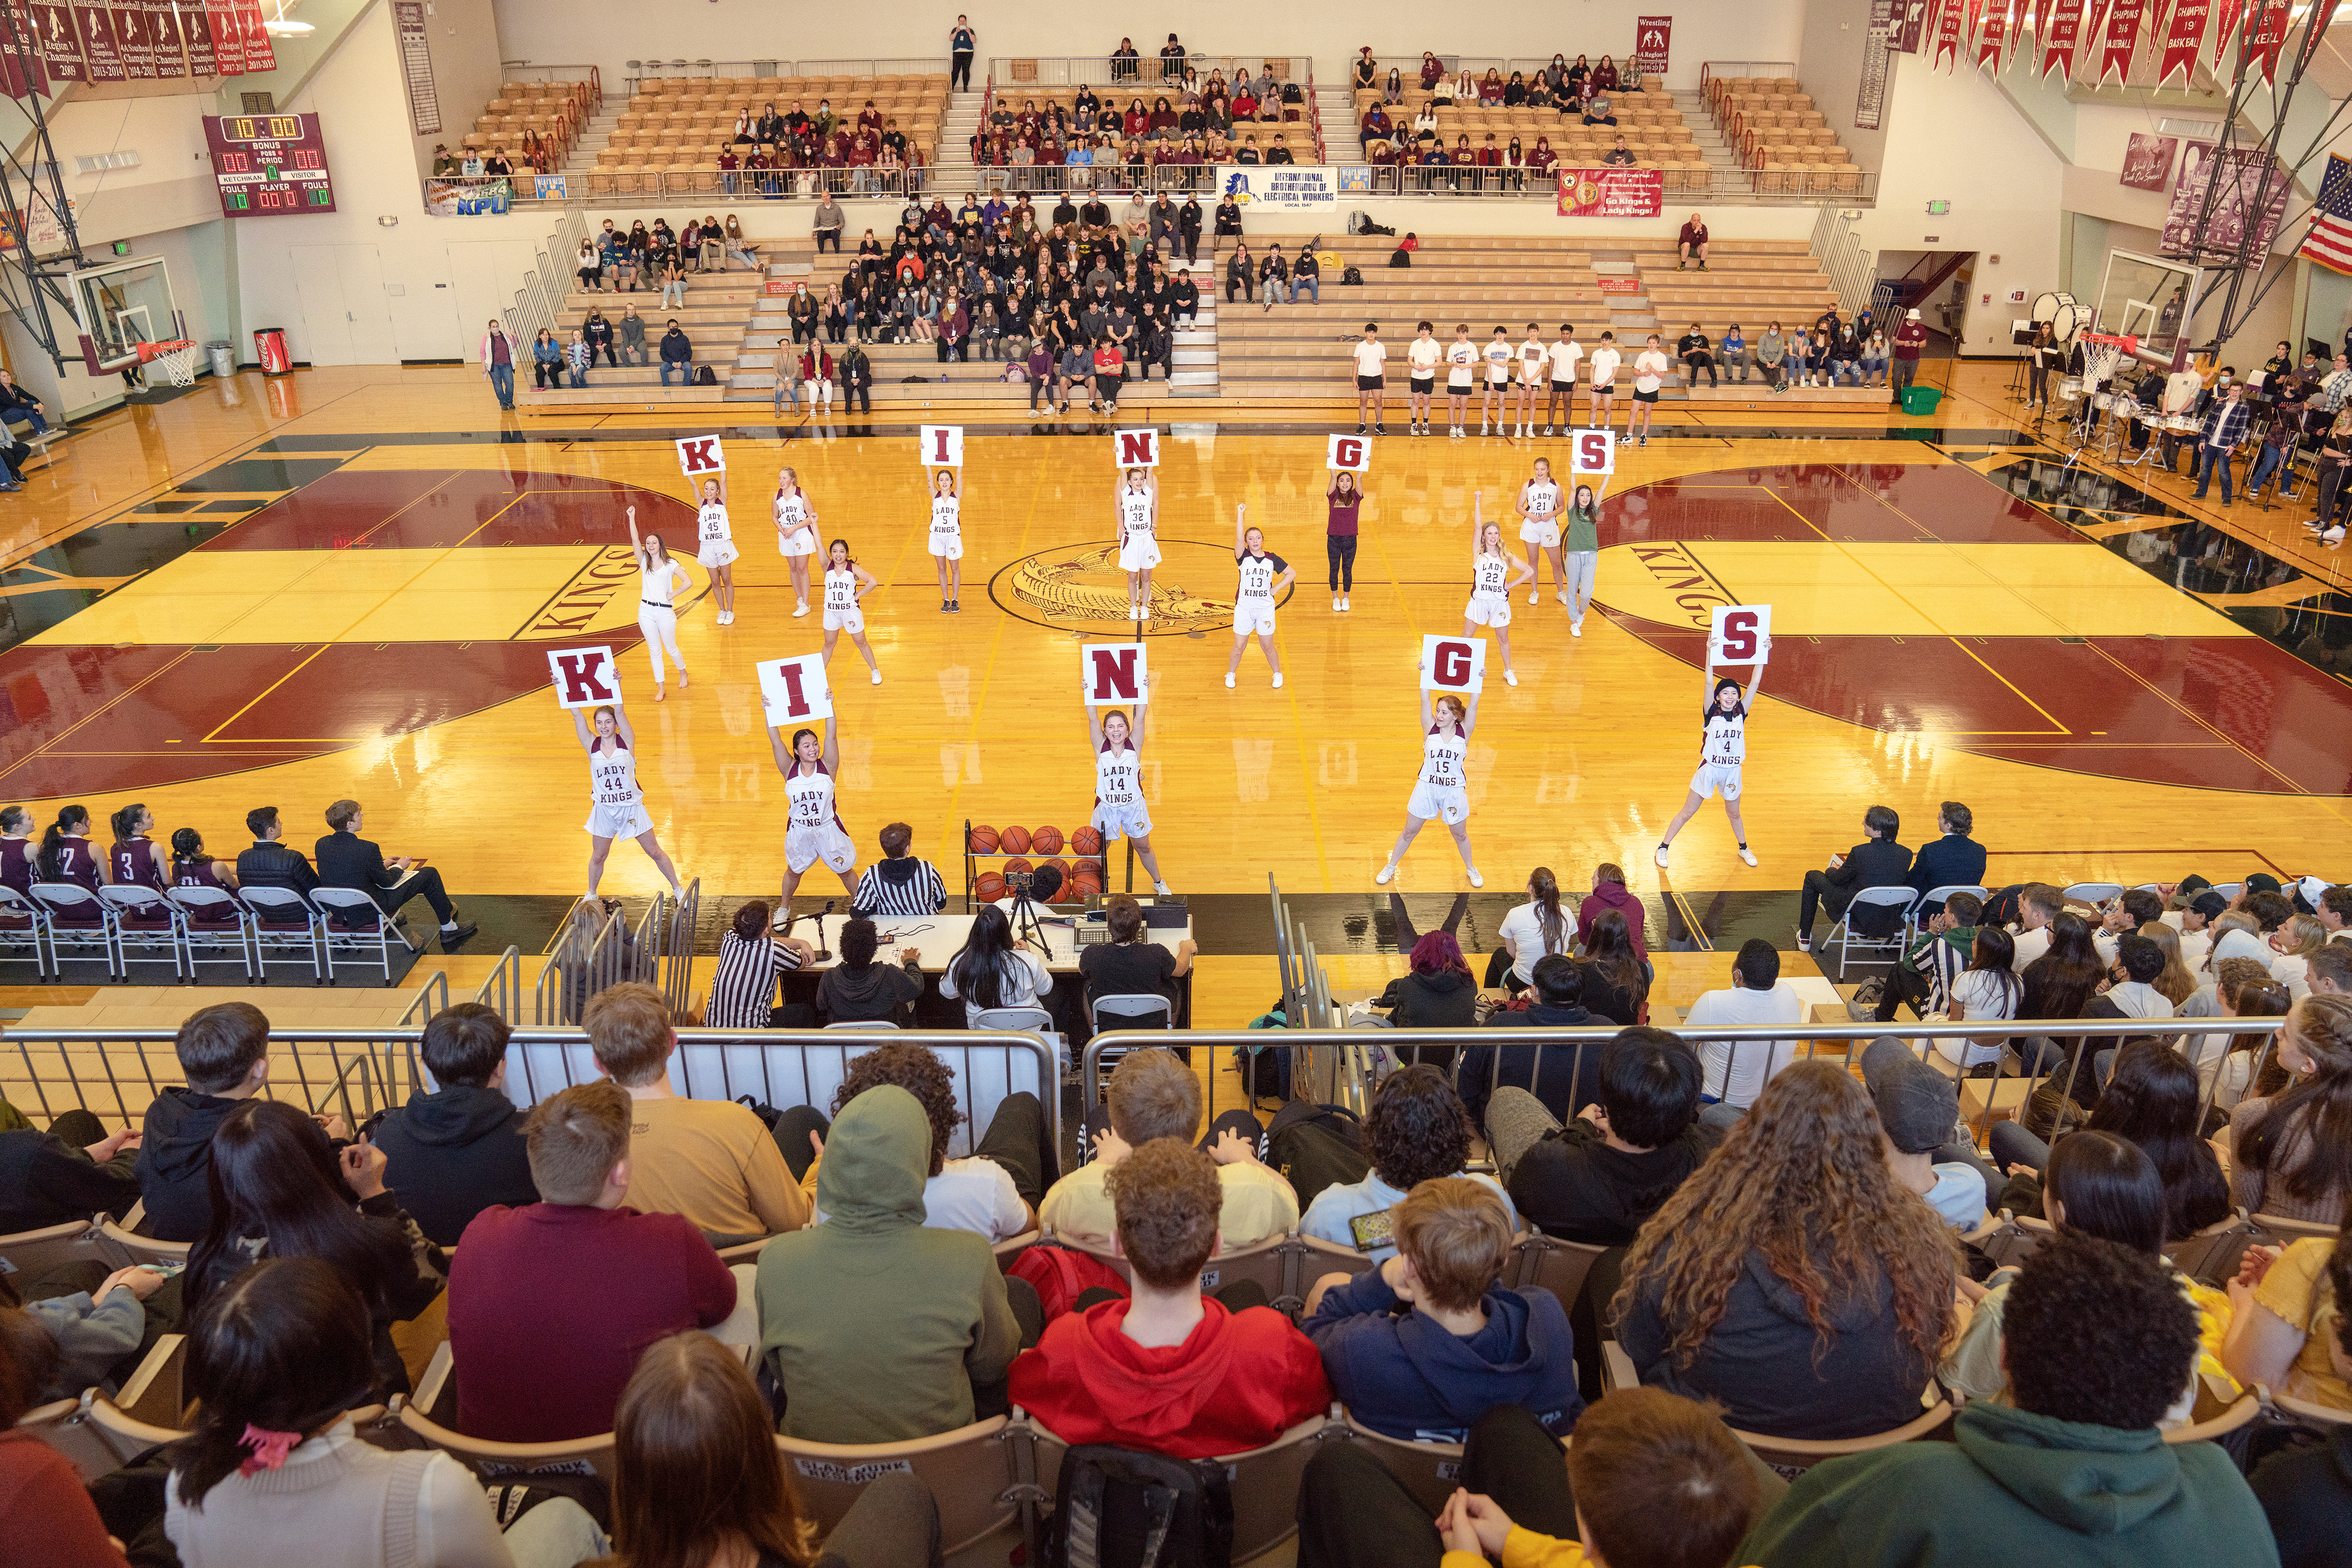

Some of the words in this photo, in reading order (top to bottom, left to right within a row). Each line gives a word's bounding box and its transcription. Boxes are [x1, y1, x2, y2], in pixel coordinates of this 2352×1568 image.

[73, 0, 106, 8] Basketball
[110, 0, 141, 10] Basketball
[142, 2, 172, 12] Basketball
[177, 3, 204, 12] Basketball
[206, 3, 233, 12] Basketball
[235, 2, 260, 10] Basketball
[1640, 19, 1671, 27] Wrestling
[44, 40, 68, 51] Region
[68, 41, 74, 51] V
[120, 44, 129, 52] 4A
[154, 45, 162, 53] 4A
[162, 44, 177, 53] Region
[188, 43, 196, 51] 4A
[196, 42, 209, 51] Region
[45, 51, 82, 63] Champions
[92, 50, 114, 58] Champions
[189, 55, 215, 63] Champions
[155, 55, 184, 65] Champions
[248, 59, 275, 70] 2018-2019
[60, 65, 76, 76] 2009
[93, 66, 124, 77] 2013-2014
[252, 142, 280, 150] BONUS
[1275, 172, 1323, 182] INTERNATIONAL
[221, 185, 248, 193] FOULS
[260, 183, 290, 191] PLAYER
[303, 181, 328, 189] FOULS
[1271, 183, 1316, 191] BROTHERHOOD
[1319, 183, 1327, 191] OF
[480, 185, 507, 198] 684
[1264, 193, 1299, 201] ELECTRICAL
[1303, 193, 1333, 201] WORKERS
[457, 196, 507, 216] KPU
[1933, 203, 1945, 212] EXIT
[256, 336, 271, 369] Coca-Cola
[935, 430, 949, 462] I
[1121, 433, 1152, 464] N
[682, 440, 719, 471] K
[1336, 438, 1362, 467] G
[1581, 435, 1606, 469] S
[781, 506, 798, 514] LADY
[936, 507, 955, 515] LADY
[1537, 502, 1546, 511] 21
[704, 513, 721, 522] LADY
[786, 514, 797, 522] 40
[943, 516, 947, 524] 5
[1132, 513, 1143, 521] 32
[707, 522, 719, 531] 45
[705, 532, 723, 540] KINGS
[1246, 568, 1269, 577] LADY
[1482, 563, 1504, 573] LADY
[1251, 578, 1263, 587] 13
[1485, 572, 1498, 583] 22
[829, 581, 849, 590] LADY
[1481, 584, 1502, 593] KINGS
[832, 591, 844, 601] 10
[1244, 589, 1268, 597] KINGS
[1723, 612, 1758, 660] S
[1433, 642, 1472, 687] G
[557, 652, 613, 702] K
[1092, 649, 1138, 699] N
[780, 662, 810, 717] I
[1715, 729, 1741, 739] LADY
[1724, 741, 1730, 752] 4
[1430, 748, 1459, 761] LADY
[1712, 755, 1740, 765] KINGS
[596, 765, 626, 778] LADY
[1104, 766, 1131, 777] LADY
[1436, 761, 1449, 773] 15
[605, 778, 623, 790] 44
[1110, 778, 1125, 790] 14
[1429, 775, 1456, 787] KINGS
[601, 792, 632, 803] KINGS
[793, 792, 823, 803] LADY
[1105, 793, 1133, 803] KINGS
[801, 803, 818, 815] 34
[122, 853, 134, 880] 3
